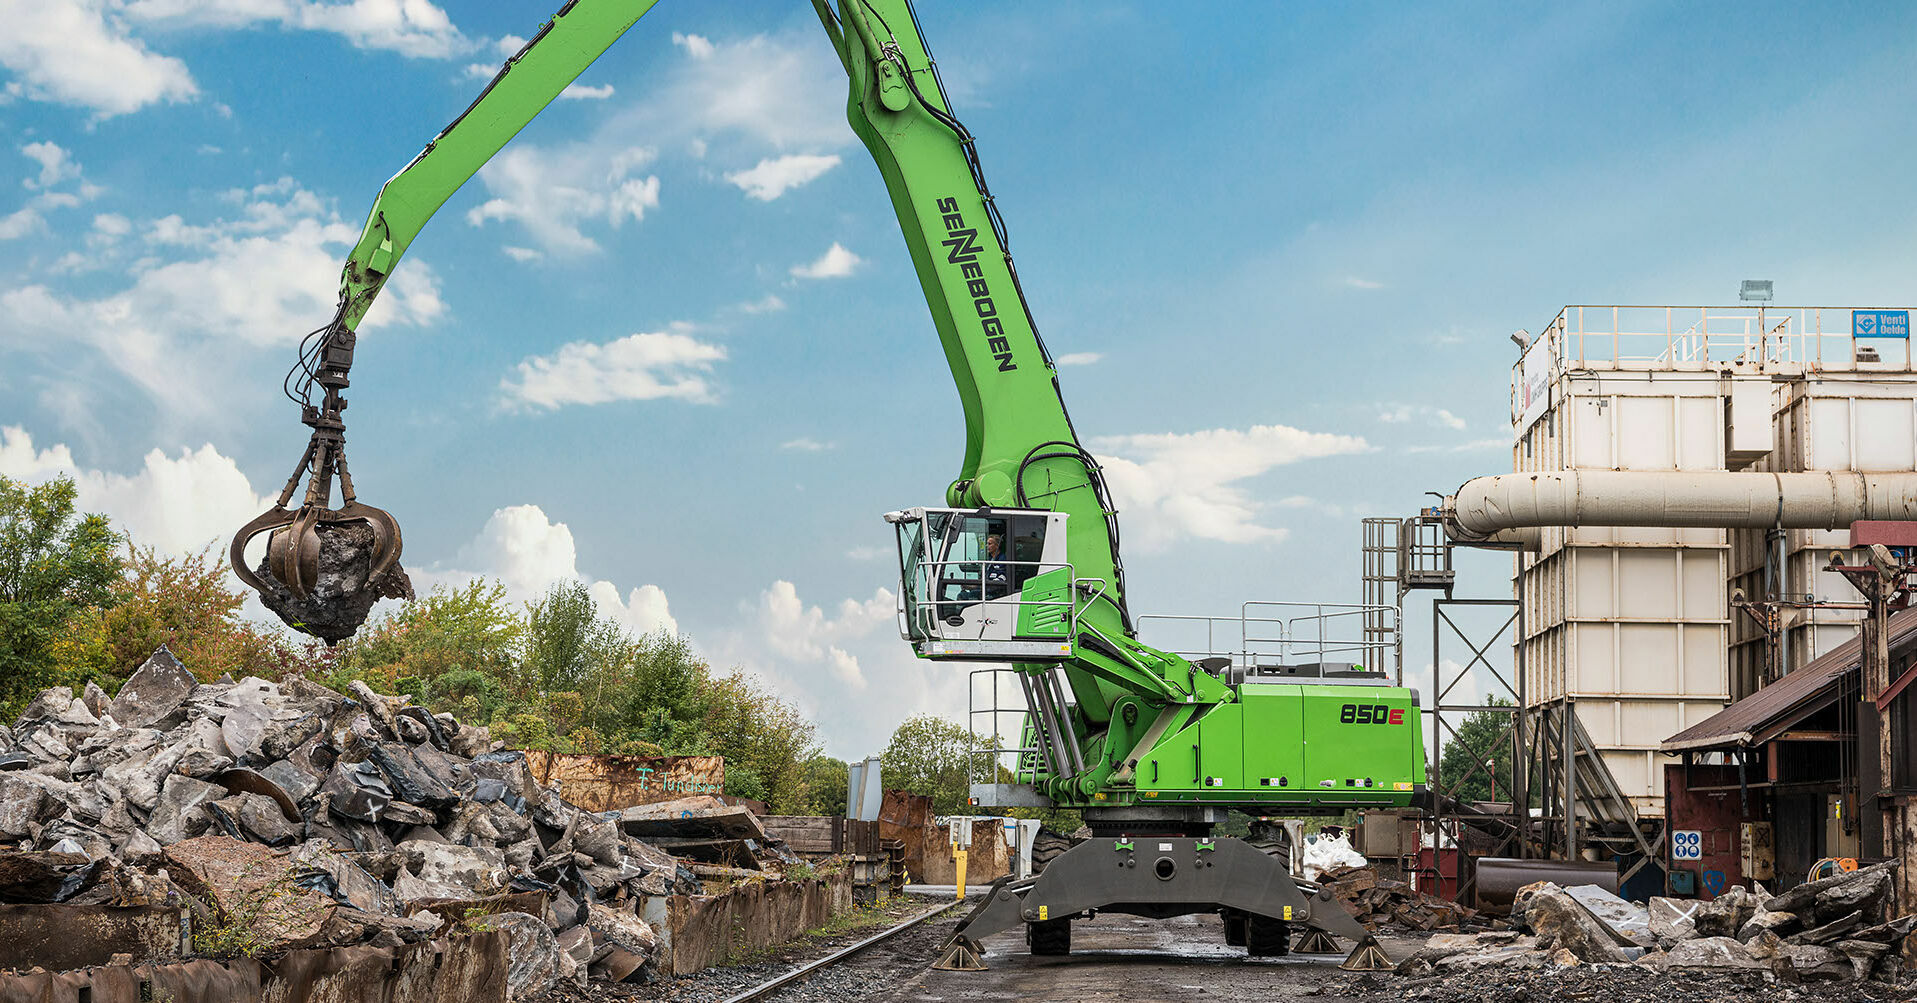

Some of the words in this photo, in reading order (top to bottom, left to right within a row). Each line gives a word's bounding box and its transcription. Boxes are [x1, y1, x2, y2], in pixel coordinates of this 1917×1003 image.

[936, 196, 1019, 373] SENNEBOGEN
[1880, 314, 1906, 325] Venti
[1880, 325, 1906, 335] Oelde
[1340, 704, 1405, 725] 850E
